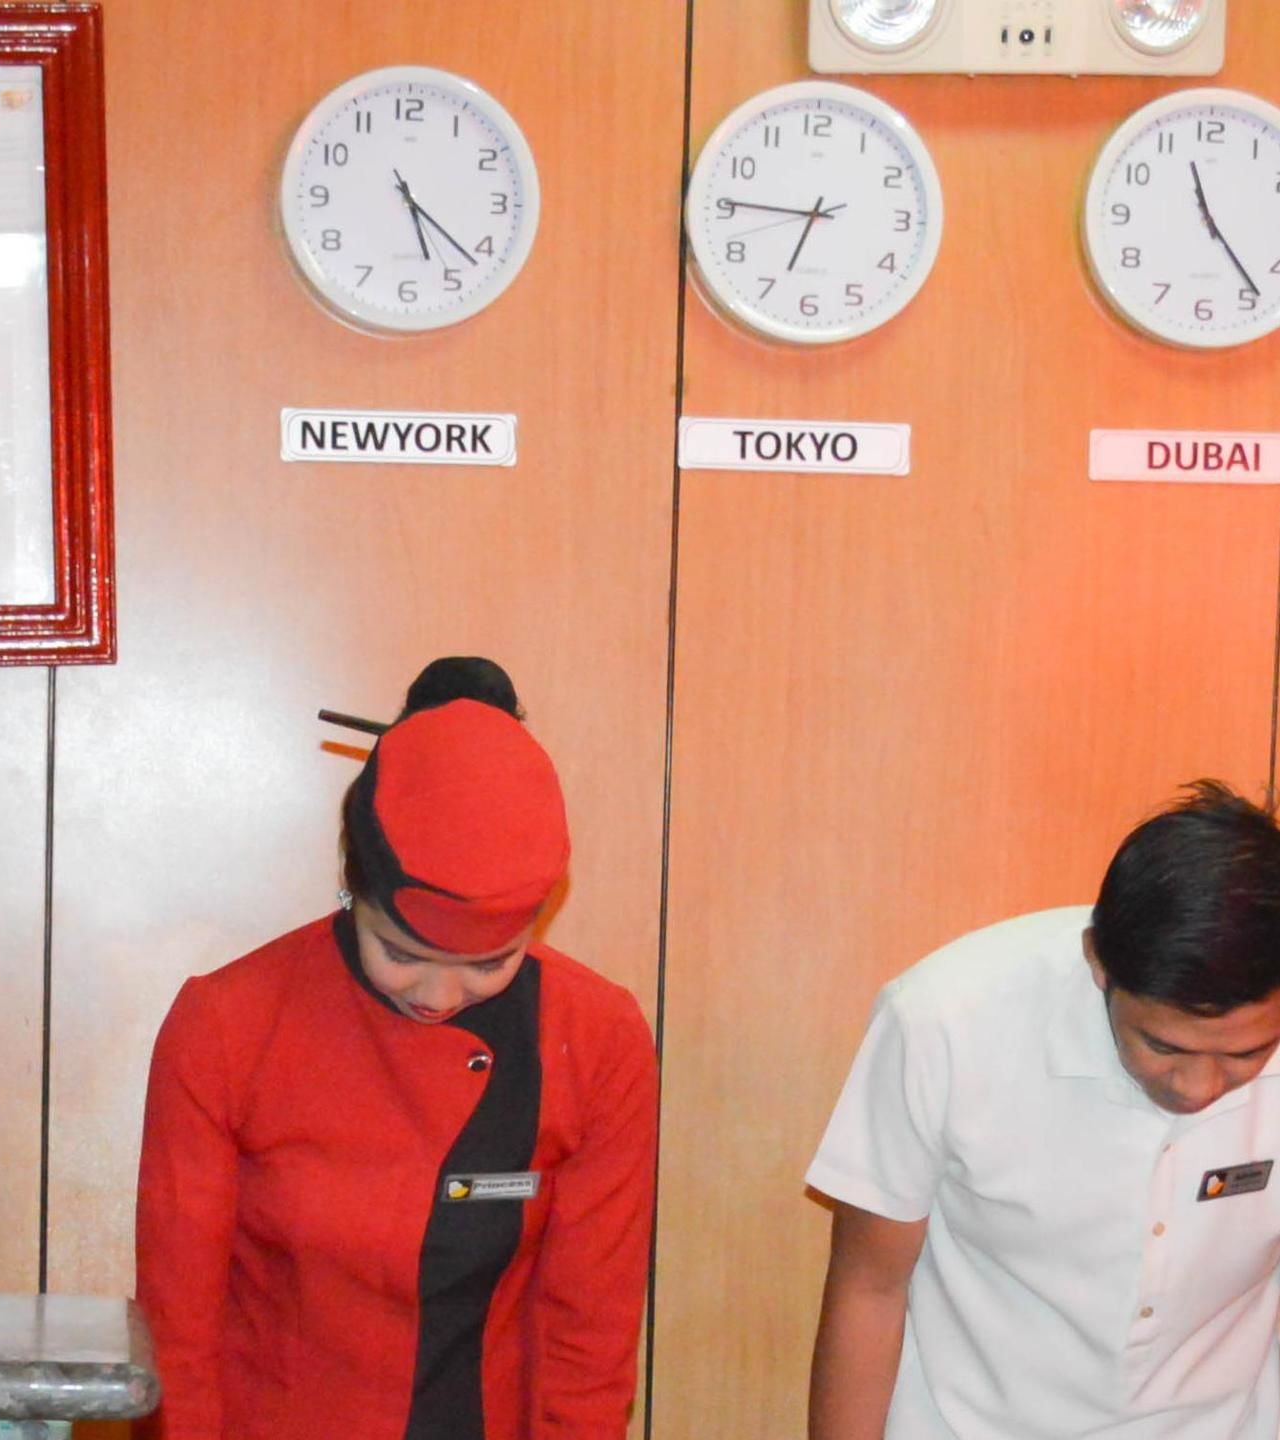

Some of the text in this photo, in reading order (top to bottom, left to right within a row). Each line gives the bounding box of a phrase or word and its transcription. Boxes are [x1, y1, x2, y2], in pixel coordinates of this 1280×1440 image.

[395, 98, 424, 121] 12
[356, 111, 371, 133] 11
[453, 115, 459, 137] 1
[803, 114, 832, 137] 12
[1197, 121, 1225, 143] 12
[763, 126, 780, 148] 11
[860, 133, 866, 153] 1
[1157, 133, 1173, 154] 11
[323, 143, 349, 166] 10
[478, 148, 498, 171] 2
[1252, 139, 1258, 160] 1
[732, 157, 756, 180] 10
[883, 167, 902, 188] 2
[1126, 163, 1150, 186] 10
[310, 185, 330, 207] 9
[490, 192, 508, 215] 3
[716, 198, 735, 219] 9
[1111, 204, 1131, 225] 9
[893, 210, 911, 232] 3
[321, 229, 341, 251] 8
[475, 236, 494, 256] 4
[726, 241, 746, 263] 8
[877, 253, 896, 273] 4
[1121, 247, 1141, 268] 8
[354, 266, 373, 287] 7
[443, 269, 462, 291] 5
[398, 281, 417, 302] 6
[758, 278, 776, 300] 7
[845, 284, 864, 306] 5
[1152, 283, 1171, 305] 7
[1238, 289, 1257, 310] 5
[800, 295, 819, 316] 6
[1194, 299, 1213, 321] 6
[300, 421, 492, 453] NEWYORK
[733, 430, 858, 462] TOKYO
[1147, 440, 1260, 472] DUBAI
